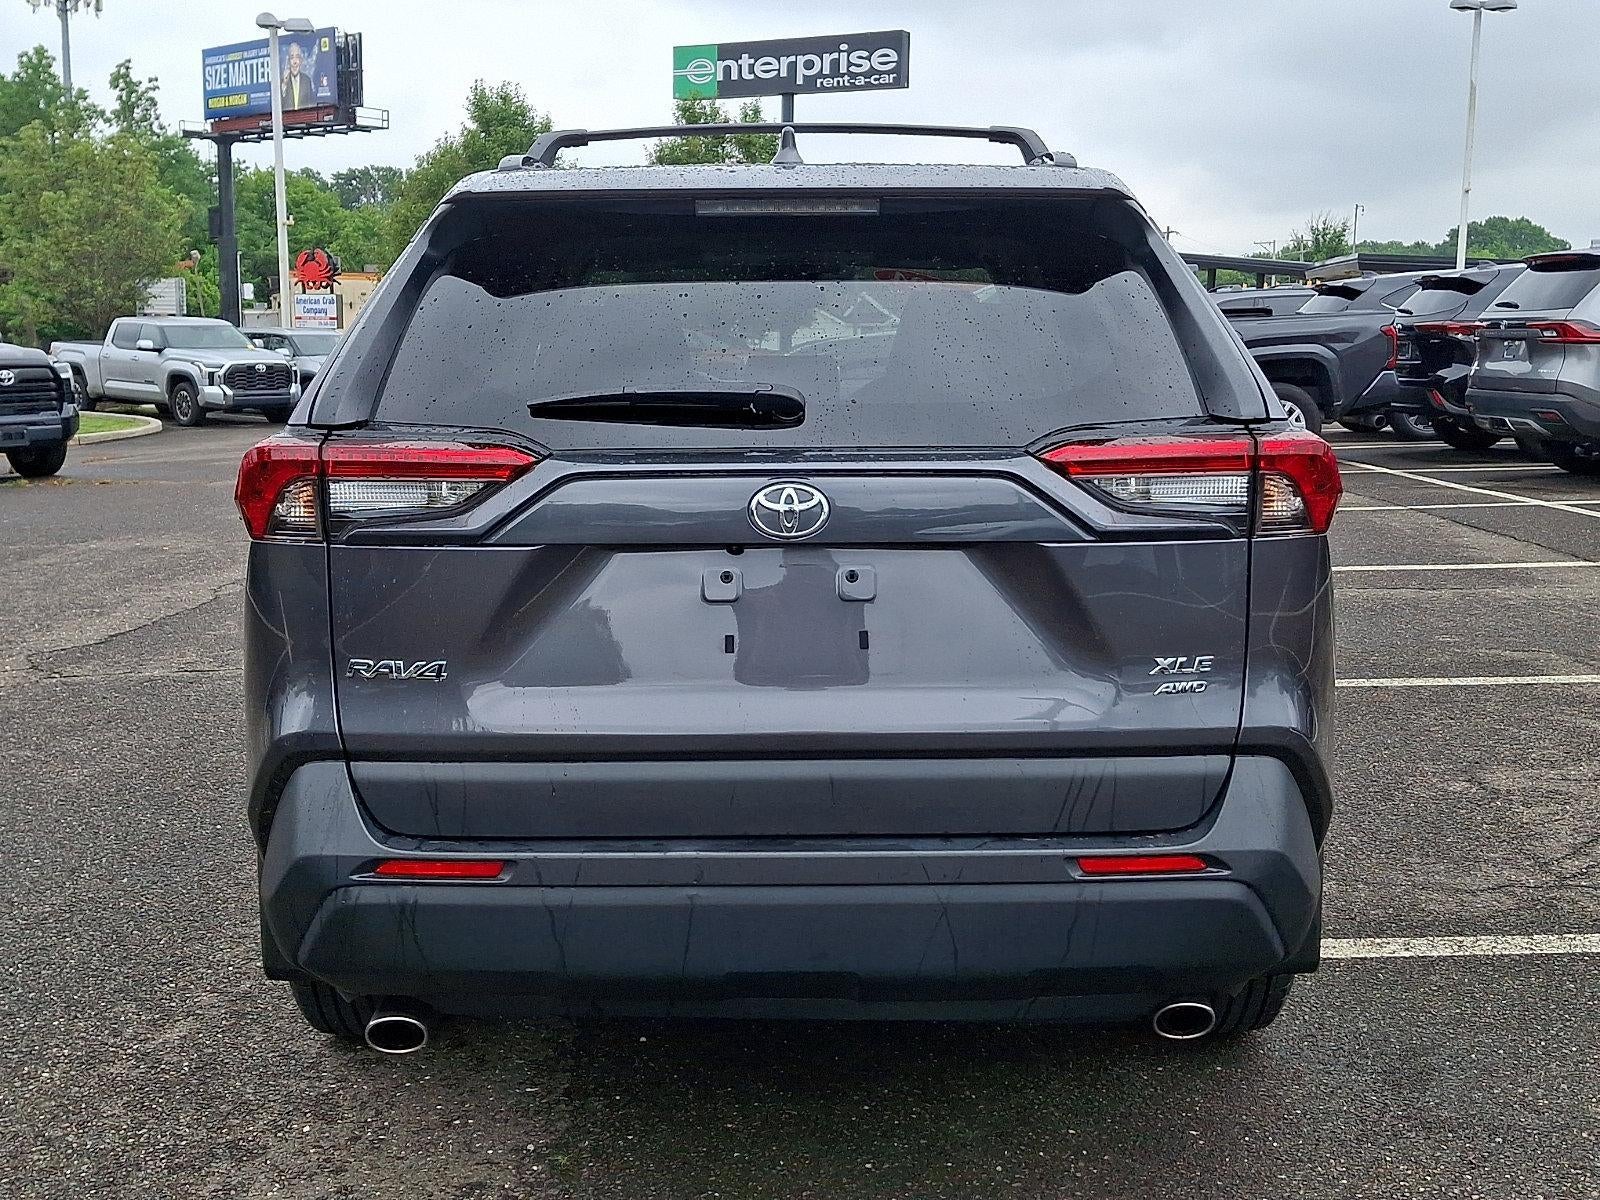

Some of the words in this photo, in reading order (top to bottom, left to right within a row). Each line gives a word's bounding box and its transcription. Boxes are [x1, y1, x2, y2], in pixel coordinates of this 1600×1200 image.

[686, 43, 899, 85] enterprise
[205, 63, 228, 91] SIZE
[228, 57, 271, 88] MATTER
[816, 72, 898, 88] rent-a-car
[296, 296, 320, 305] American
[322, 296, 335, 305] Crab
[302, 306, 327, 316] Company
[345, 659, 448, 681] RAV4
[1148, 655, 1215, 675] XLE
[1153, 681, 1208, 696] AWD
